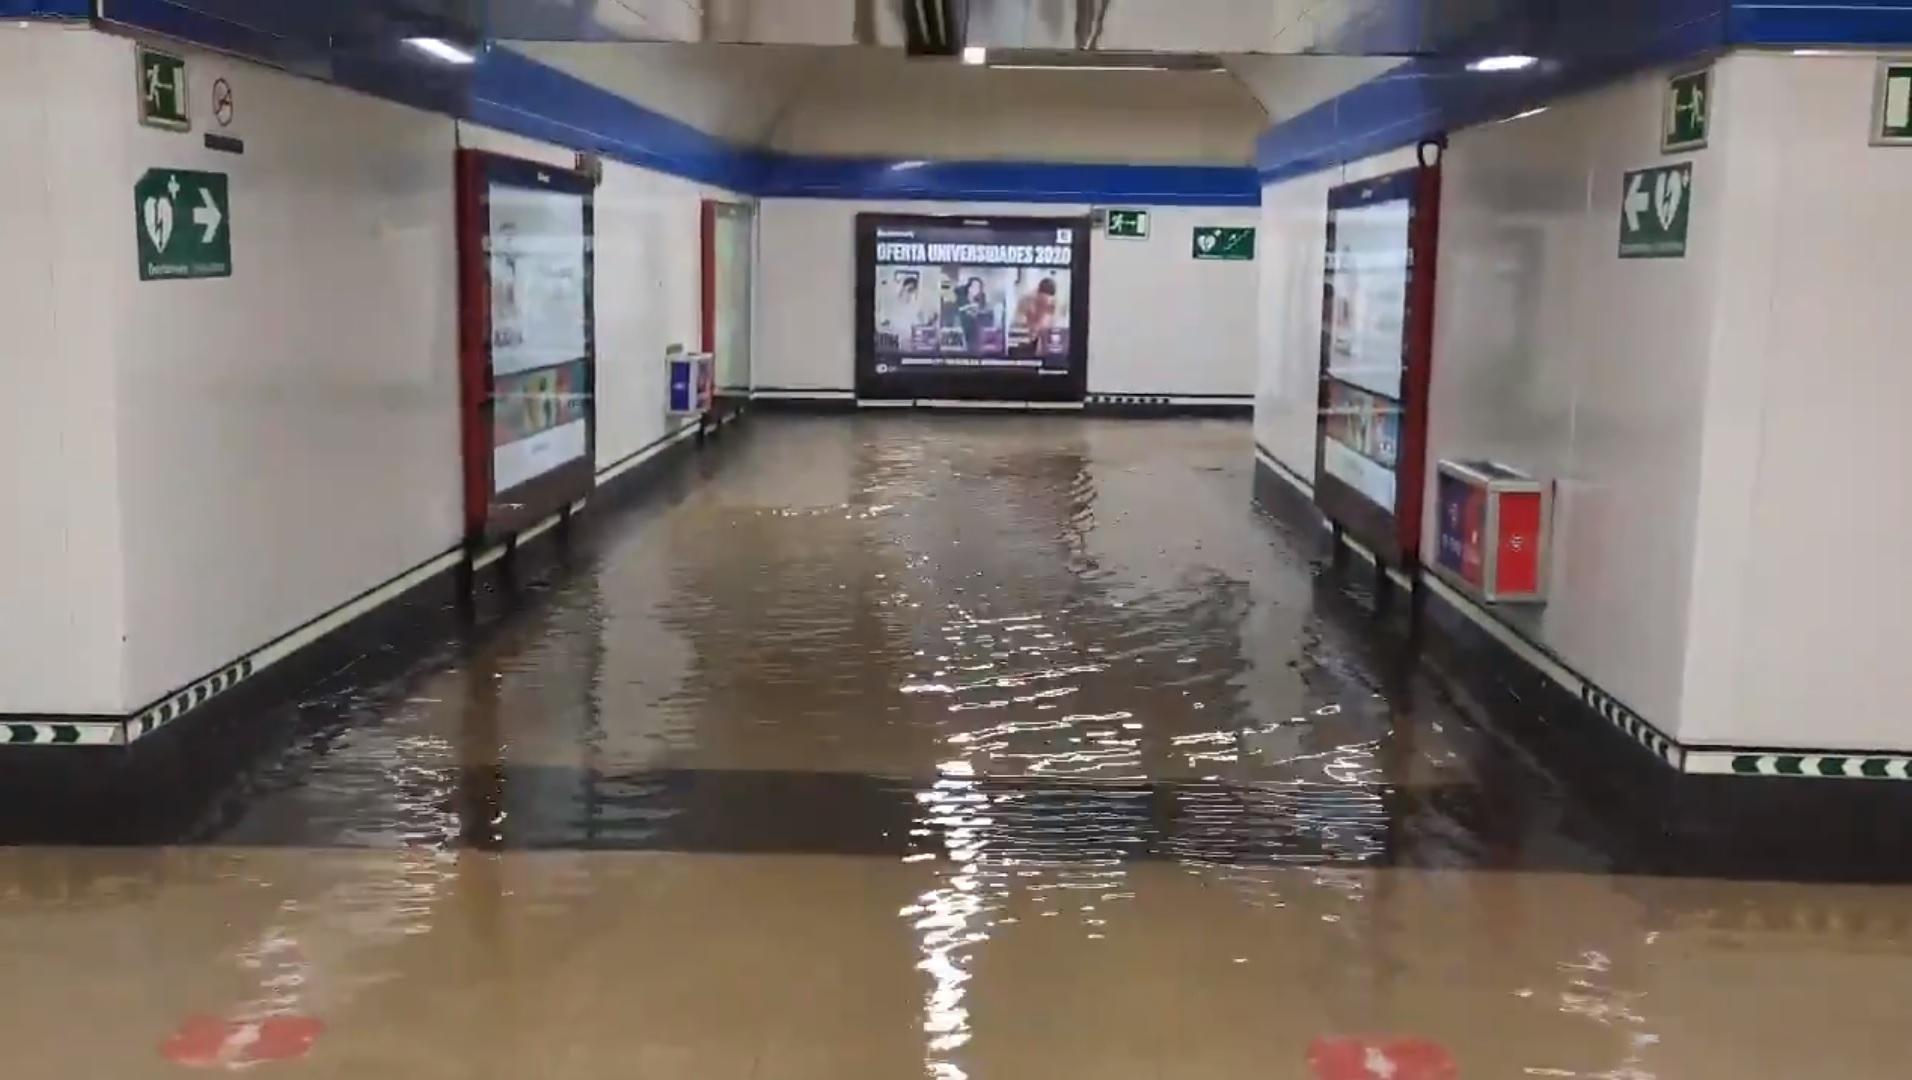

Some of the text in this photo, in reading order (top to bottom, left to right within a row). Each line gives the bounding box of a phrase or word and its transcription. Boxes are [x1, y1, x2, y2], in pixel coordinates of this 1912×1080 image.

[877, 243, 1071, 264] OFERTA UNIVERSIDADES 2020
